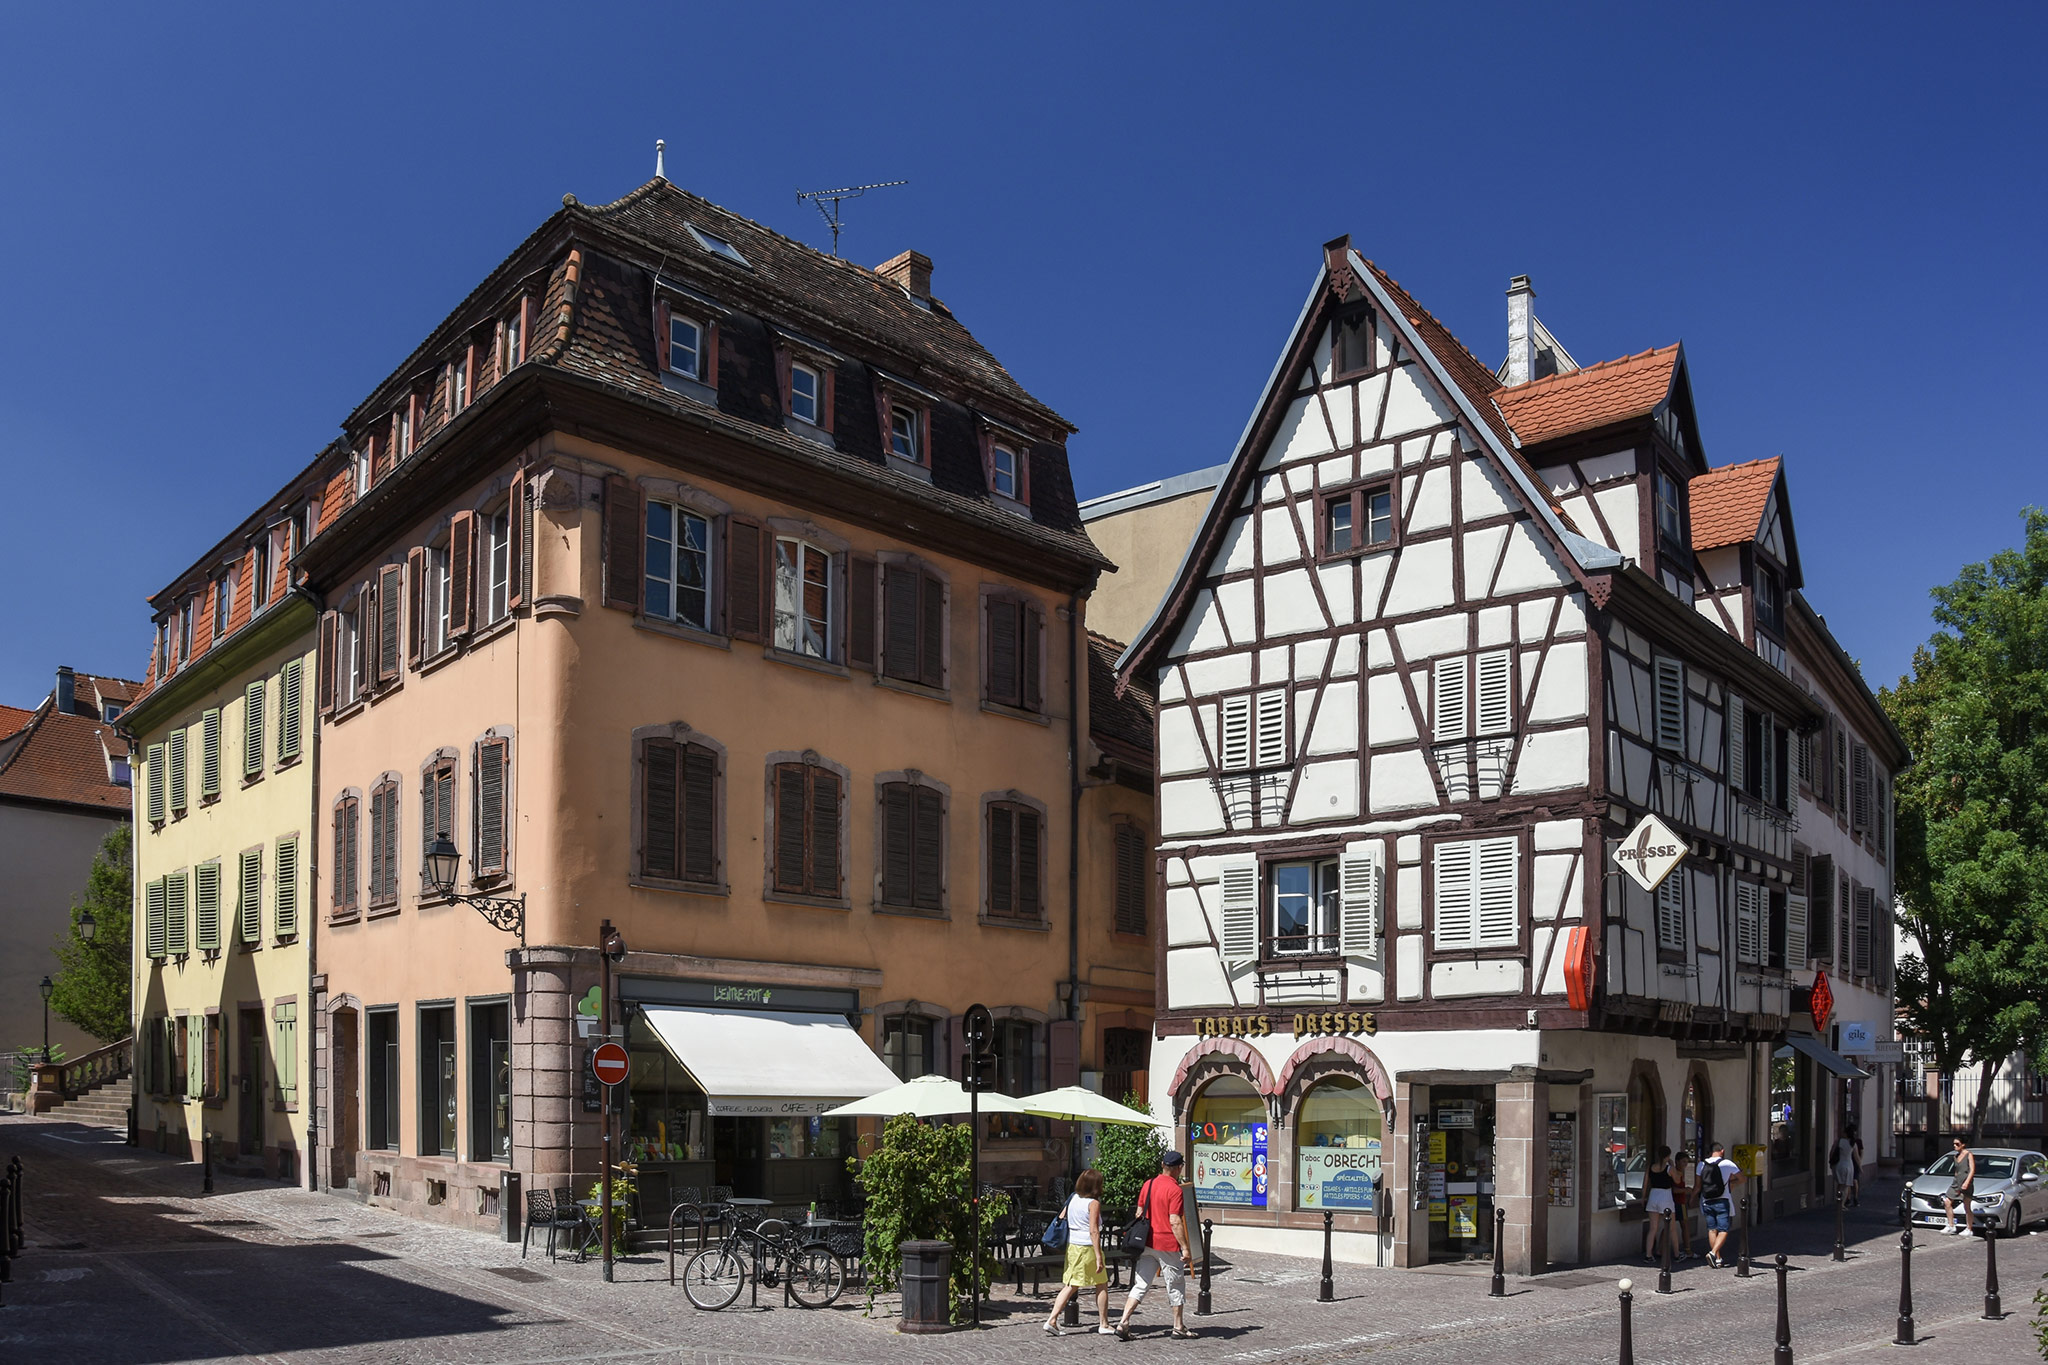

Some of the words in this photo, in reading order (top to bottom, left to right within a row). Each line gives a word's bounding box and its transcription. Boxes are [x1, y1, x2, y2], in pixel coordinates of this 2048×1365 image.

[1618, 844, 1677, 861] PRESSE
[1192, 1015, 1270, 1037] TABACS
[1293, 1012, 1376, 1040] PRESSE
[1848, 1029, 1866, 1041] gilg
[1211, 1152, 1253, 1163] OBRECHT
[1300, 1153, 1321, 1162] Tabac
[1324, 1154, 1381, 1168] OBRECHT
[1209, 1168, 1236, 1177] LOTO
